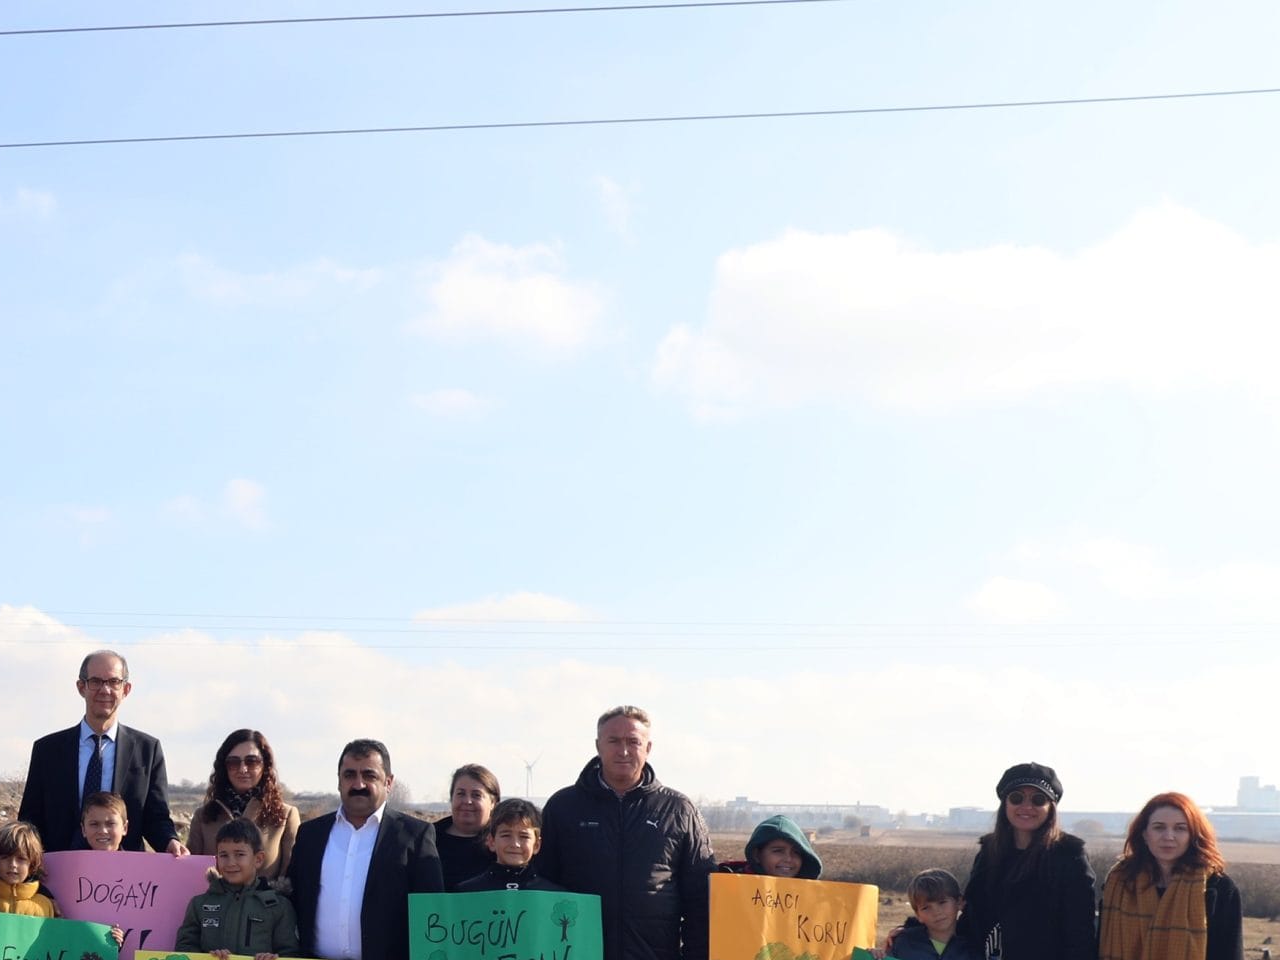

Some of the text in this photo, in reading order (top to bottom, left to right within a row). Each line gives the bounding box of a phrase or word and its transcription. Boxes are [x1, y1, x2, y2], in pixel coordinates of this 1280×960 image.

[76, 876, 159, 913] DOĞAYI
[751, 888, 799, 914] AĞACI
[425, 910, 526, 955] BUGÜN
[797, 914, 847, 946] KORU
